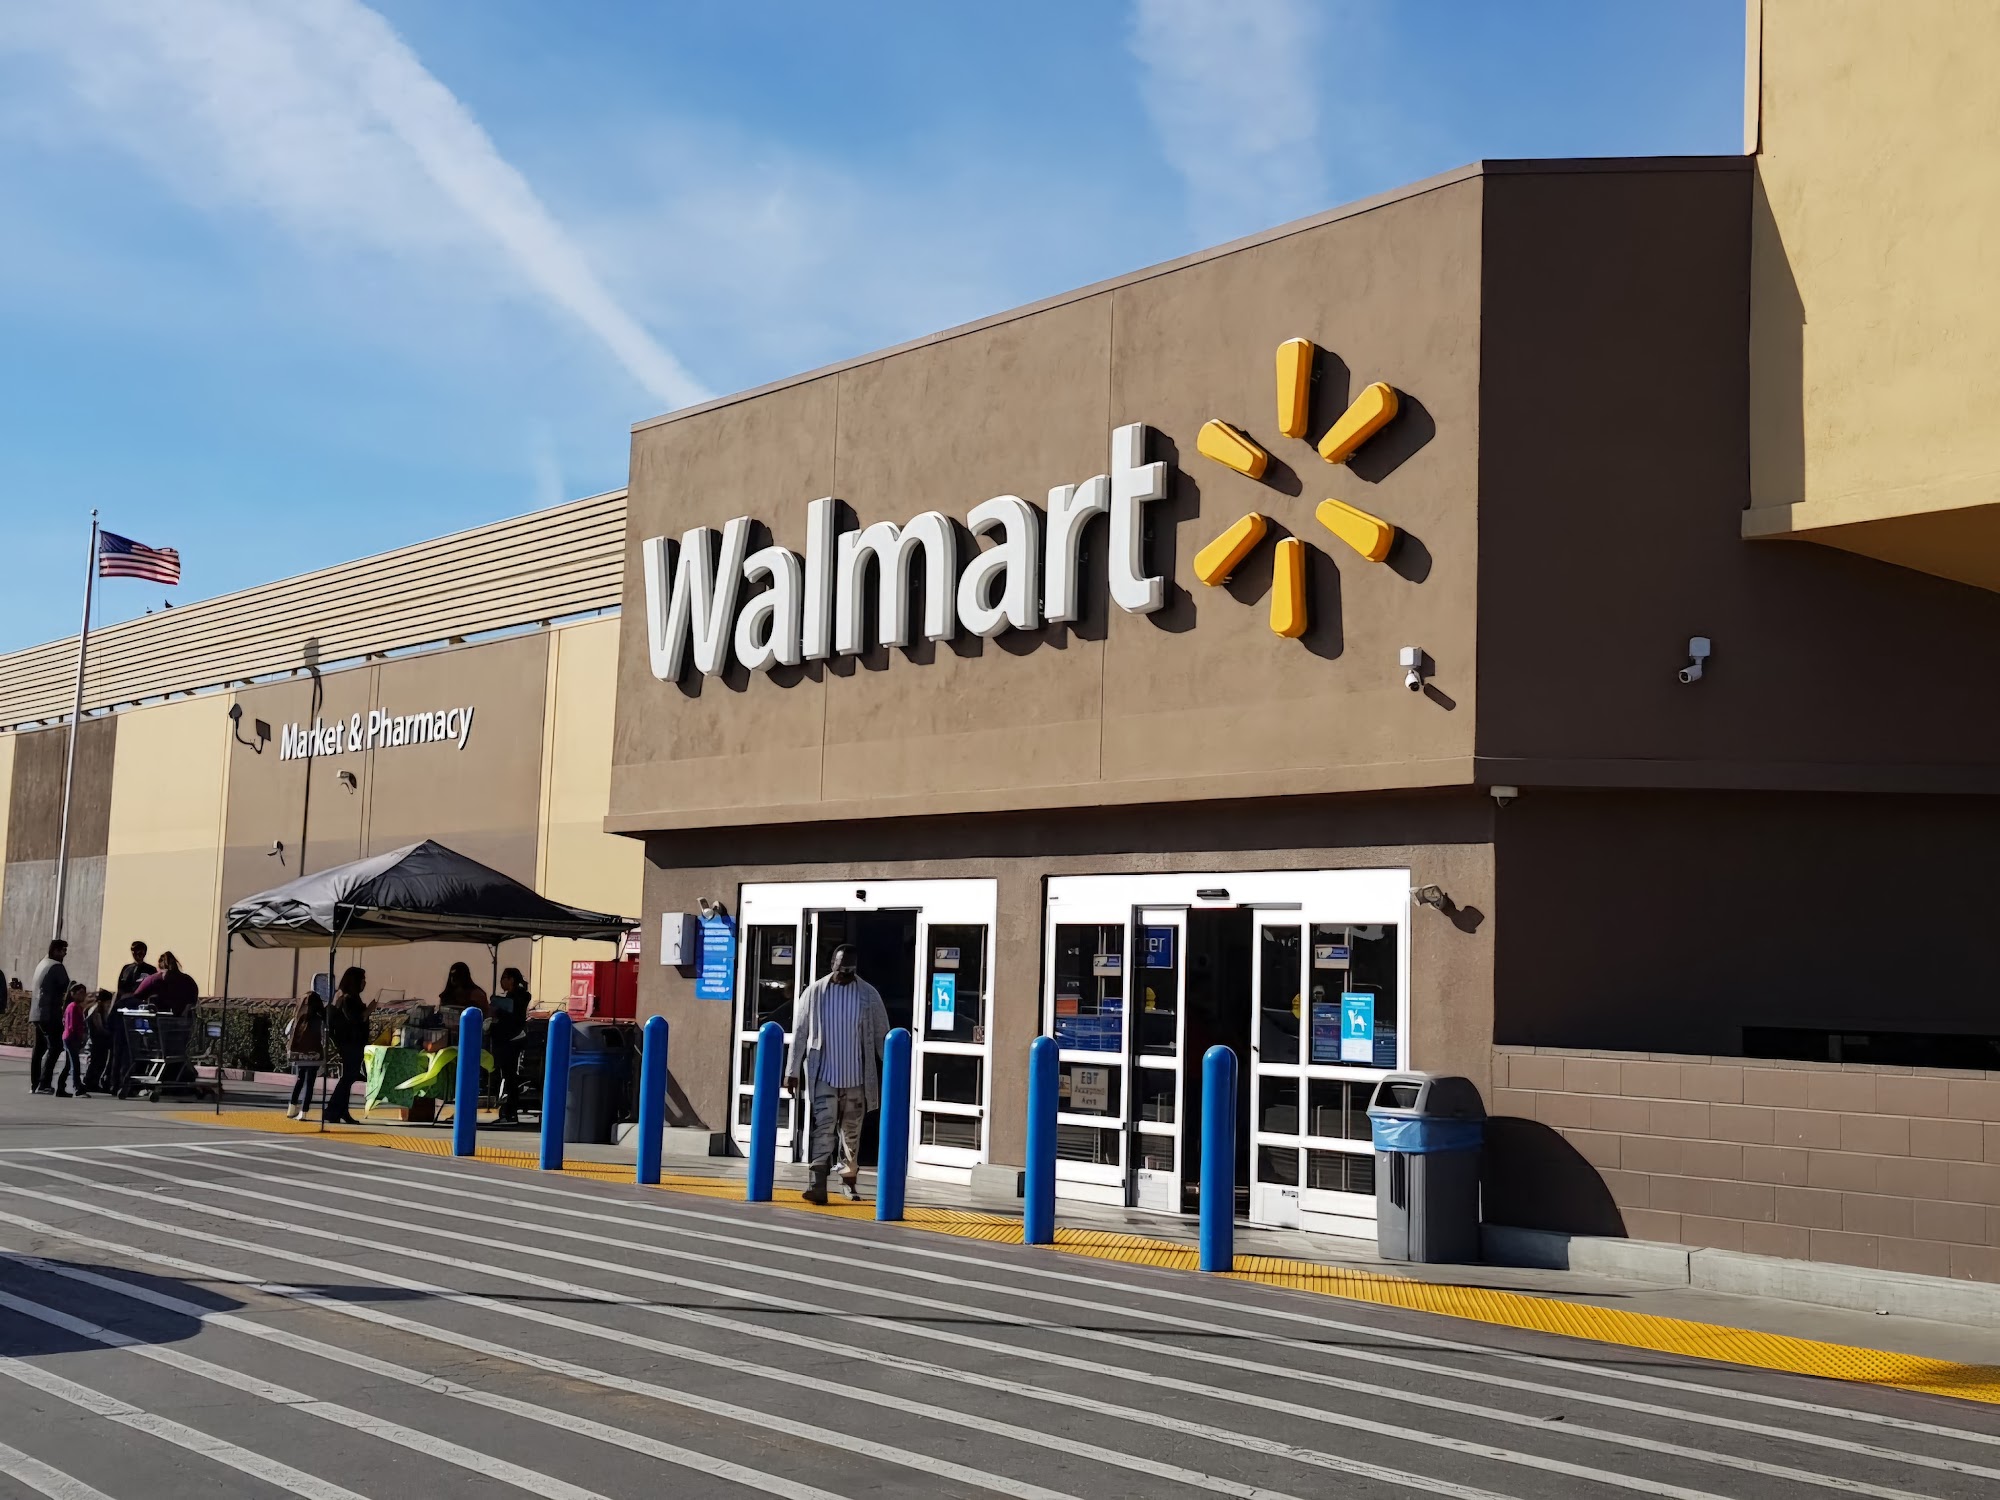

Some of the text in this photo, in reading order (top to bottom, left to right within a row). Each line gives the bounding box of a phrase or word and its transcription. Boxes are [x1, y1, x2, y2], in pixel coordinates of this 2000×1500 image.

[643, 422, 1167, 682] Walmart
[280, 706, 475, 761] Market & Pharmacy
[1081, 1071, 1099, 1085] EBT
